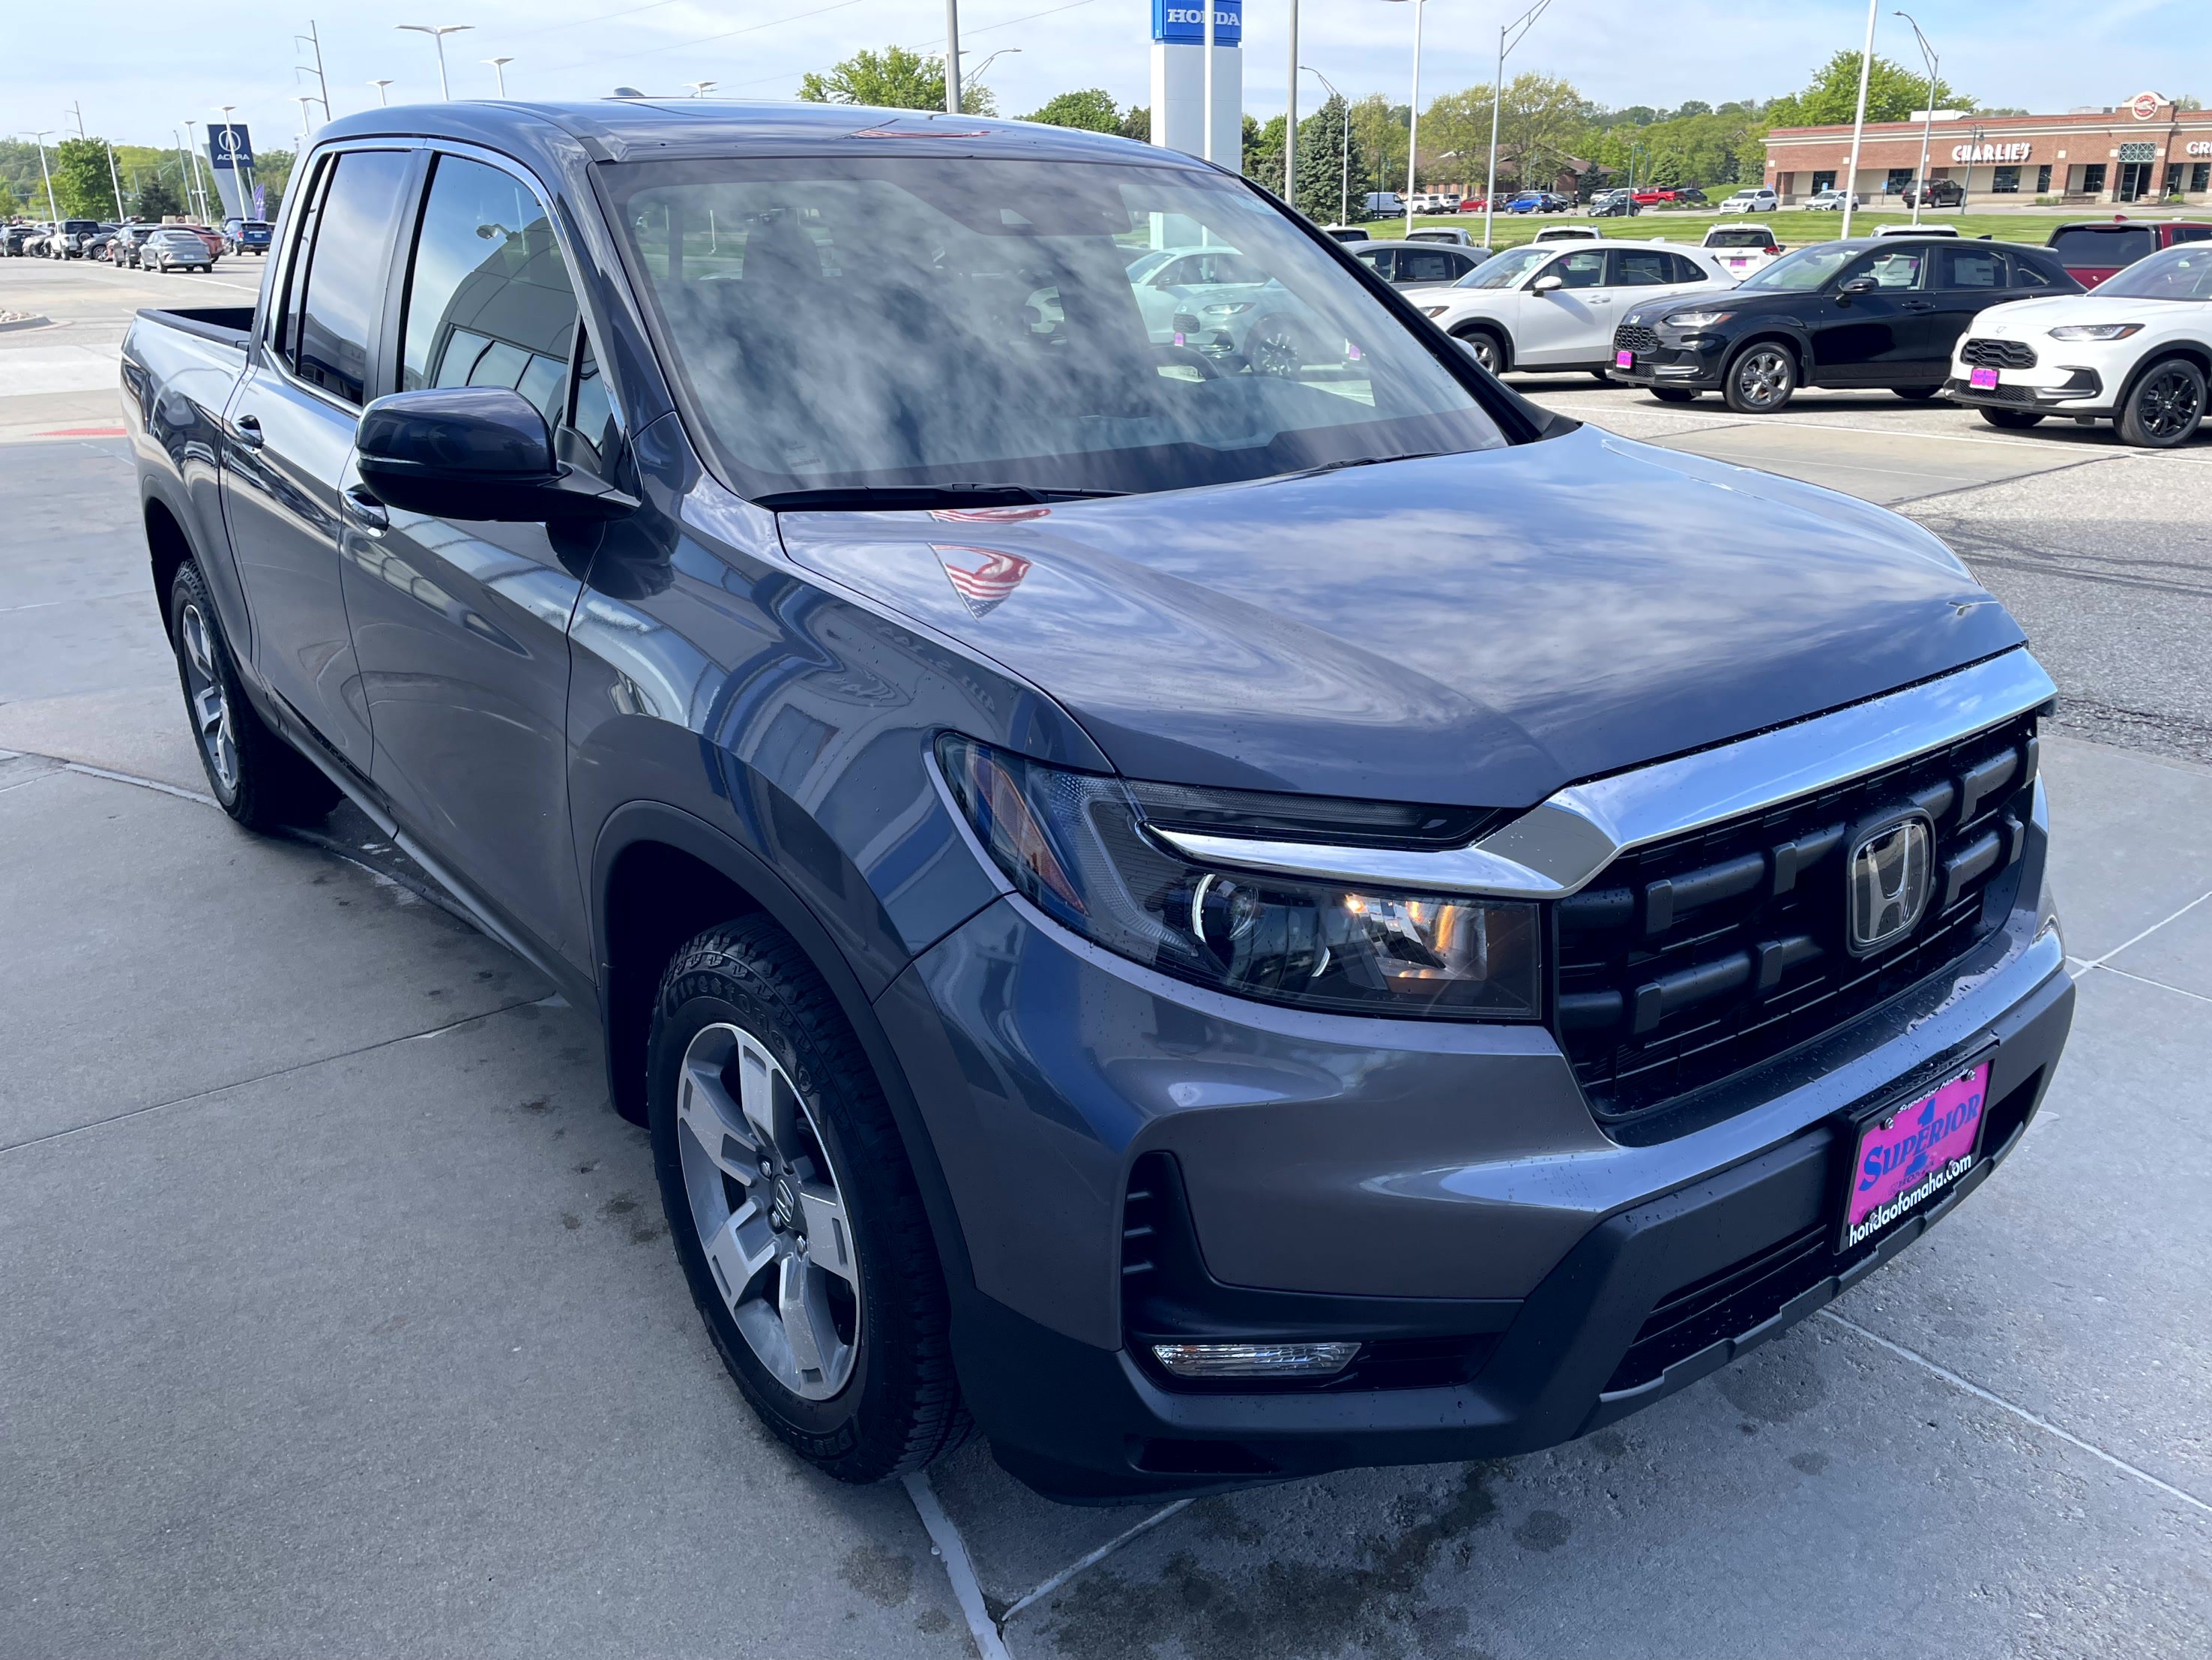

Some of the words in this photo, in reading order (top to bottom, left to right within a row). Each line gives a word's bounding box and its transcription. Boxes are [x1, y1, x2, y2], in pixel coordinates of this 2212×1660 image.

[1952, 142, 2031, 162] CHARLIE'S
[2186, 141, 2212, 155] GR
[1897, 1086, 1939, 1114] Superior
[1858, 1093, 1981, 1191] SUPERIOR
[1848, 1155, 1972, 1248] hondaofomaha.com
